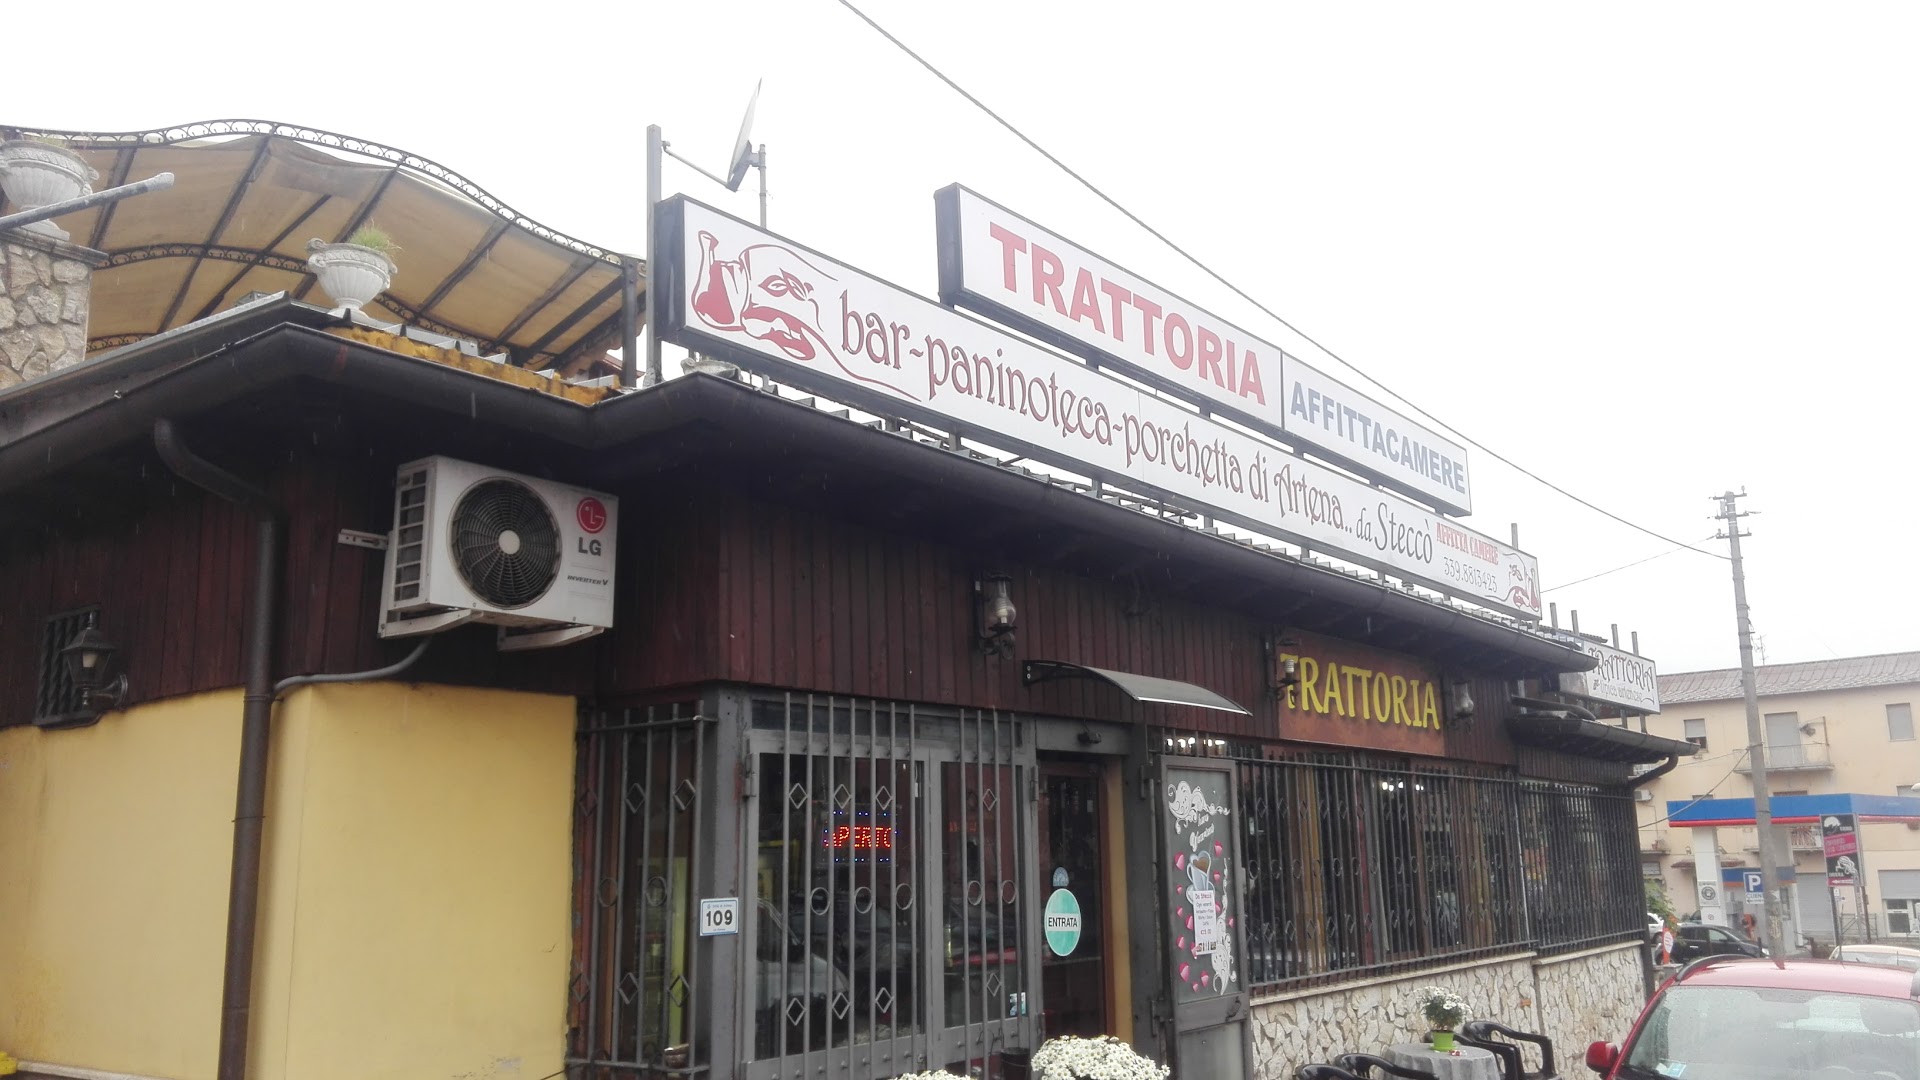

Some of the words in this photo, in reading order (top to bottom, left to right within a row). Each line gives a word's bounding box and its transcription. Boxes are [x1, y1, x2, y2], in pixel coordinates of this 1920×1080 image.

[989, 221, 1267, 406] TRATTORIA
[1290, 381, 1467, 495] AFFITTACAMERE
[1249, 455, 1270, 503] di
[1356, 507, 1374, 543] da
[1374, 501, 1433, 565] Steccò
[578, 536, 602, 557] LG
[1436, 522, 1469, 554] AFFITTA
[1469, 536, 1499, 566] CAMERE
[567, 575, 602, 585] INVERTER
[1443, 556, 1498, 593] 339.8813423
[1588, 647, 1654, 693] TRATTORIA
[1279, 653, 1441, 730] TRATTORIA
[1748, 874, 1761, 892] P
[706, 909, 733, 927] 109
[1048, 916, 1078, 928] ENTRATA
